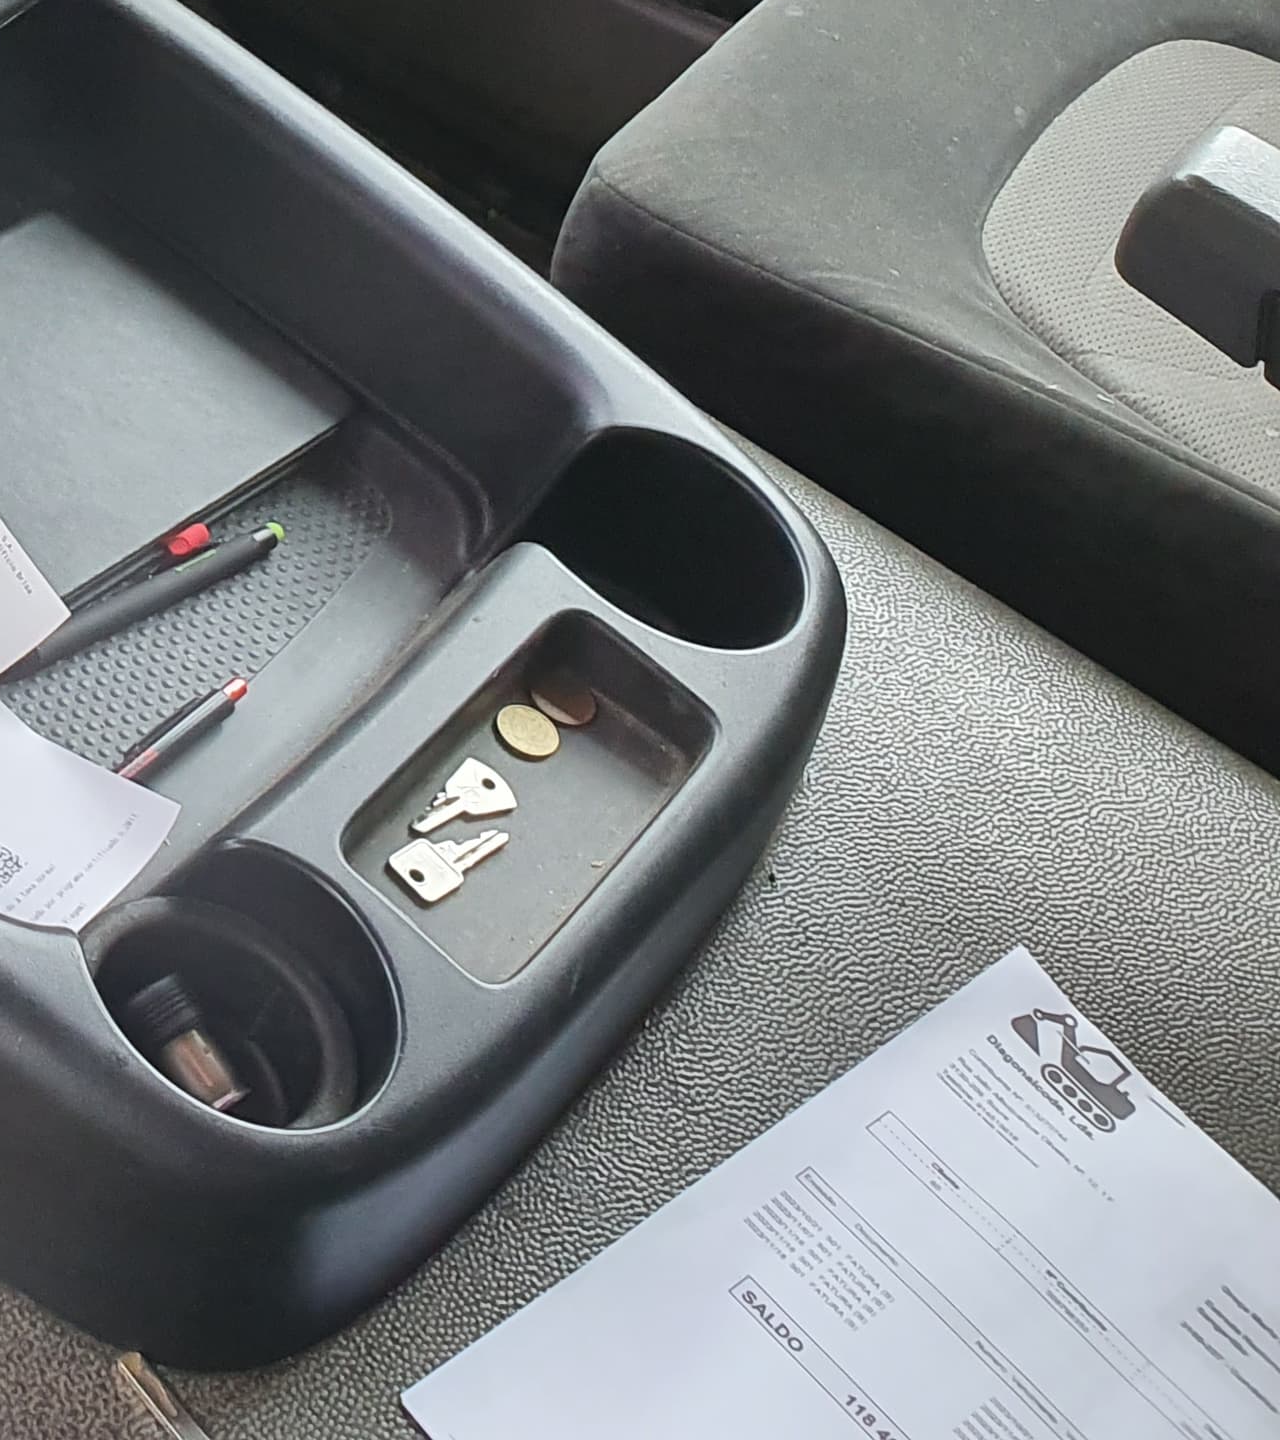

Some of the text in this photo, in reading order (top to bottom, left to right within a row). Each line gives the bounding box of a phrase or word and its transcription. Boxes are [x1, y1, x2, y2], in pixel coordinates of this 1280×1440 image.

[825, 1265, 864, 1304] FATURA
[834, 1259, 873, 1298] FATURA
[843, 1252, 882, 1290] FATURA
[807, 1279, 846, 1318] FATURA
[816, 1273, 855, 1311] FATURA
[741, 1289, 805, 1353] SALDO
[841, 1392, 878, 1428] 118
